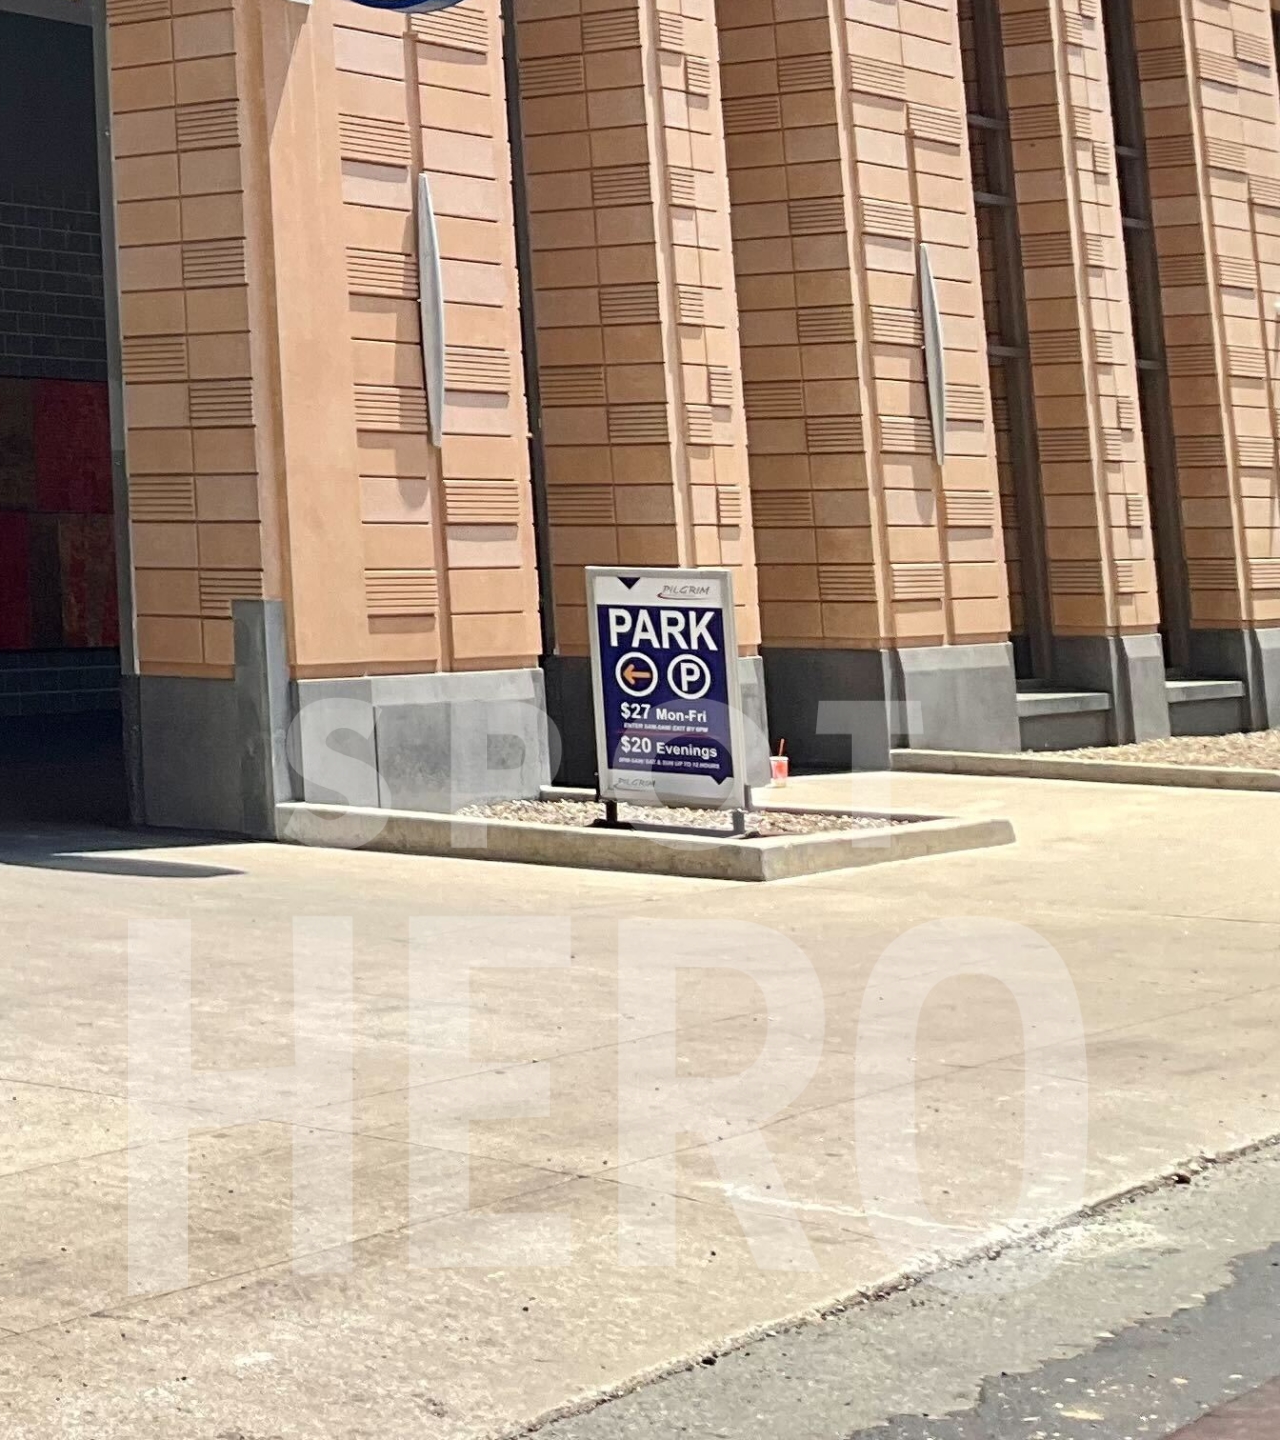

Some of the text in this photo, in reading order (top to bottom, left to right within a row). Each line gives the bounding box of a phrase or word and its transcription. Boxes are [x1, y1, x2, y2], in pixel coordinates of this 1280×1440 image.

[661, 585, 710, 595] PILGRIM
[608, 608, 718, 651] PARK
[680, 662, 701, 692] P
[620, 701, 707, 723] $27 Mon-Fri
[620, 735, 718, 760] $20 Evenings
